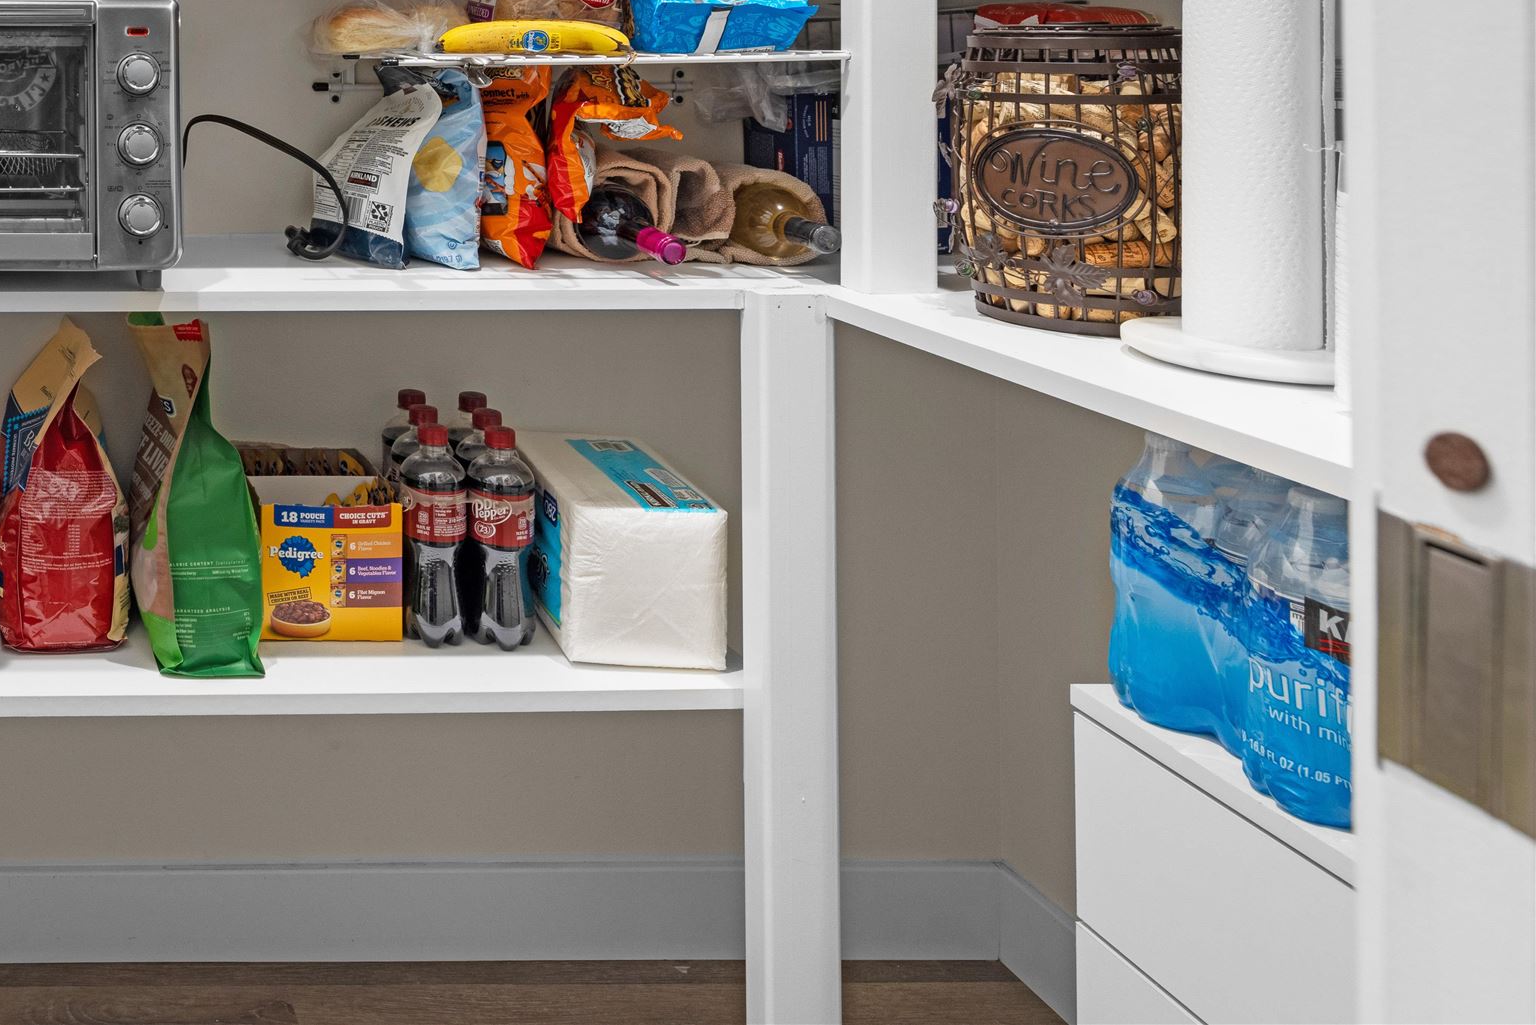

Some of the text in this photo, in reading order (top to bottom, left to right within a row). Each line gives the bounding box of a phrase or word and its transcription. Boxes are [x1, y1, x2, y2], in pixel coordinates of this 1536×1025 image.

[990, 136, 1122, 192] Wine
[350, 171, 378, 183] KIRKLAND
[473, 499, 509, 521] Pepper
[484, 499, 497, 511] Dr
[281, 511, 298, 523] 18
[479, 525, 489, 534] 23
[349, 542, 356, 550] 6
[269, 546, 324, 562] Pedigree
[349, 567, 356, 575] 6
[349, 591, 356, 599] 6
[1268, 706, 1311, 735] with
[1266, 750, 1331, 784] FL OZ (1.05
